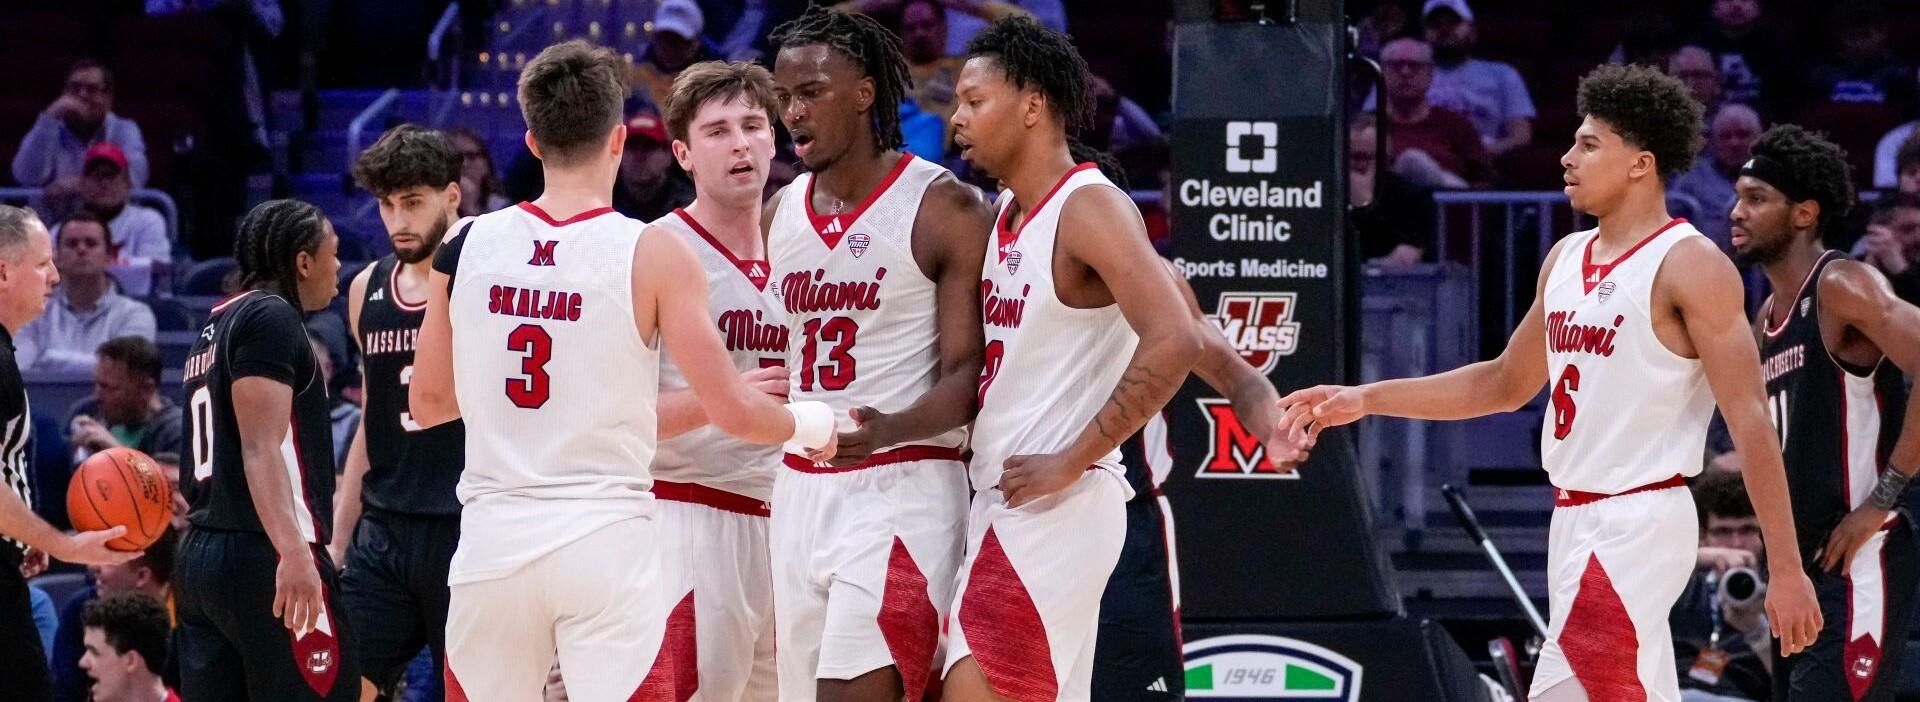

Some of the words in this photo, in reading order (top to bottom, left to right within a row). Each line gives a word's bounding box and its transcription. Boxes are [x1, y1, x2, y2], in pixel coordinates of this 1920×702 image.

[1180, 178, 1322, 208] Cleveland
[1209, 213, 1291, 242] Clinic
[527, 240, 560, 266] M
[1174, 257, 1235, 279] Sports
[1241, 258, 1327, 278] Medicine
[488, 284, 582, 322] SKALJAC
[781, 267, 887, 314] Miami
[800, 316, 859, 392] 13
[1547, 310, 1624, 357] Miami
[505, 323, 552, 409] 3
[1552, 363, 1580, 440] 6
[191, 385, 214, 481] 0
[1223, 668, 1277, 685] 1946
